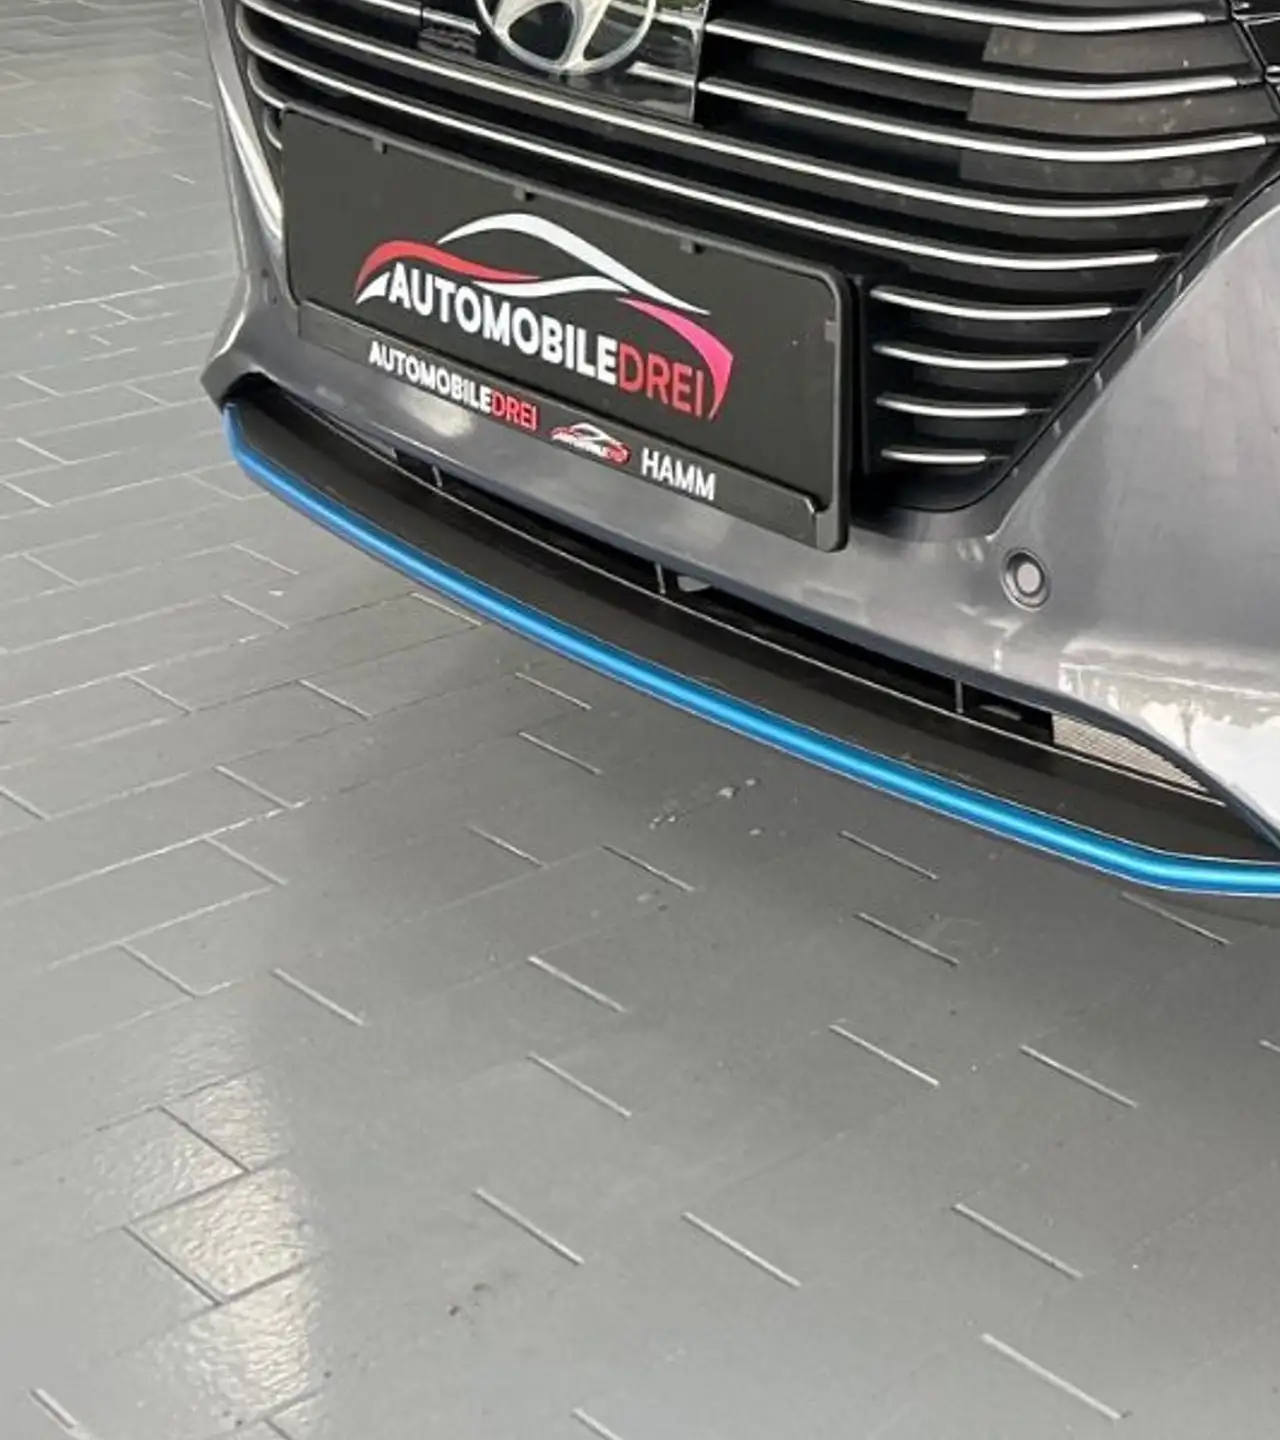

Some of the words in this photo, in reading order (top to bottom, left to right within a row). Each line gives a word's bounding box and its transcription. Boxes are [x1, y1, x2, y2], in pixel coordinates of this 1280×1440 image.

[387, 261, 705, 418] AUTOMOBILEDREI
[368, 340, 538, 432] AUTOMOBILEDREI
[640, 446, 717, 502] HAMM
